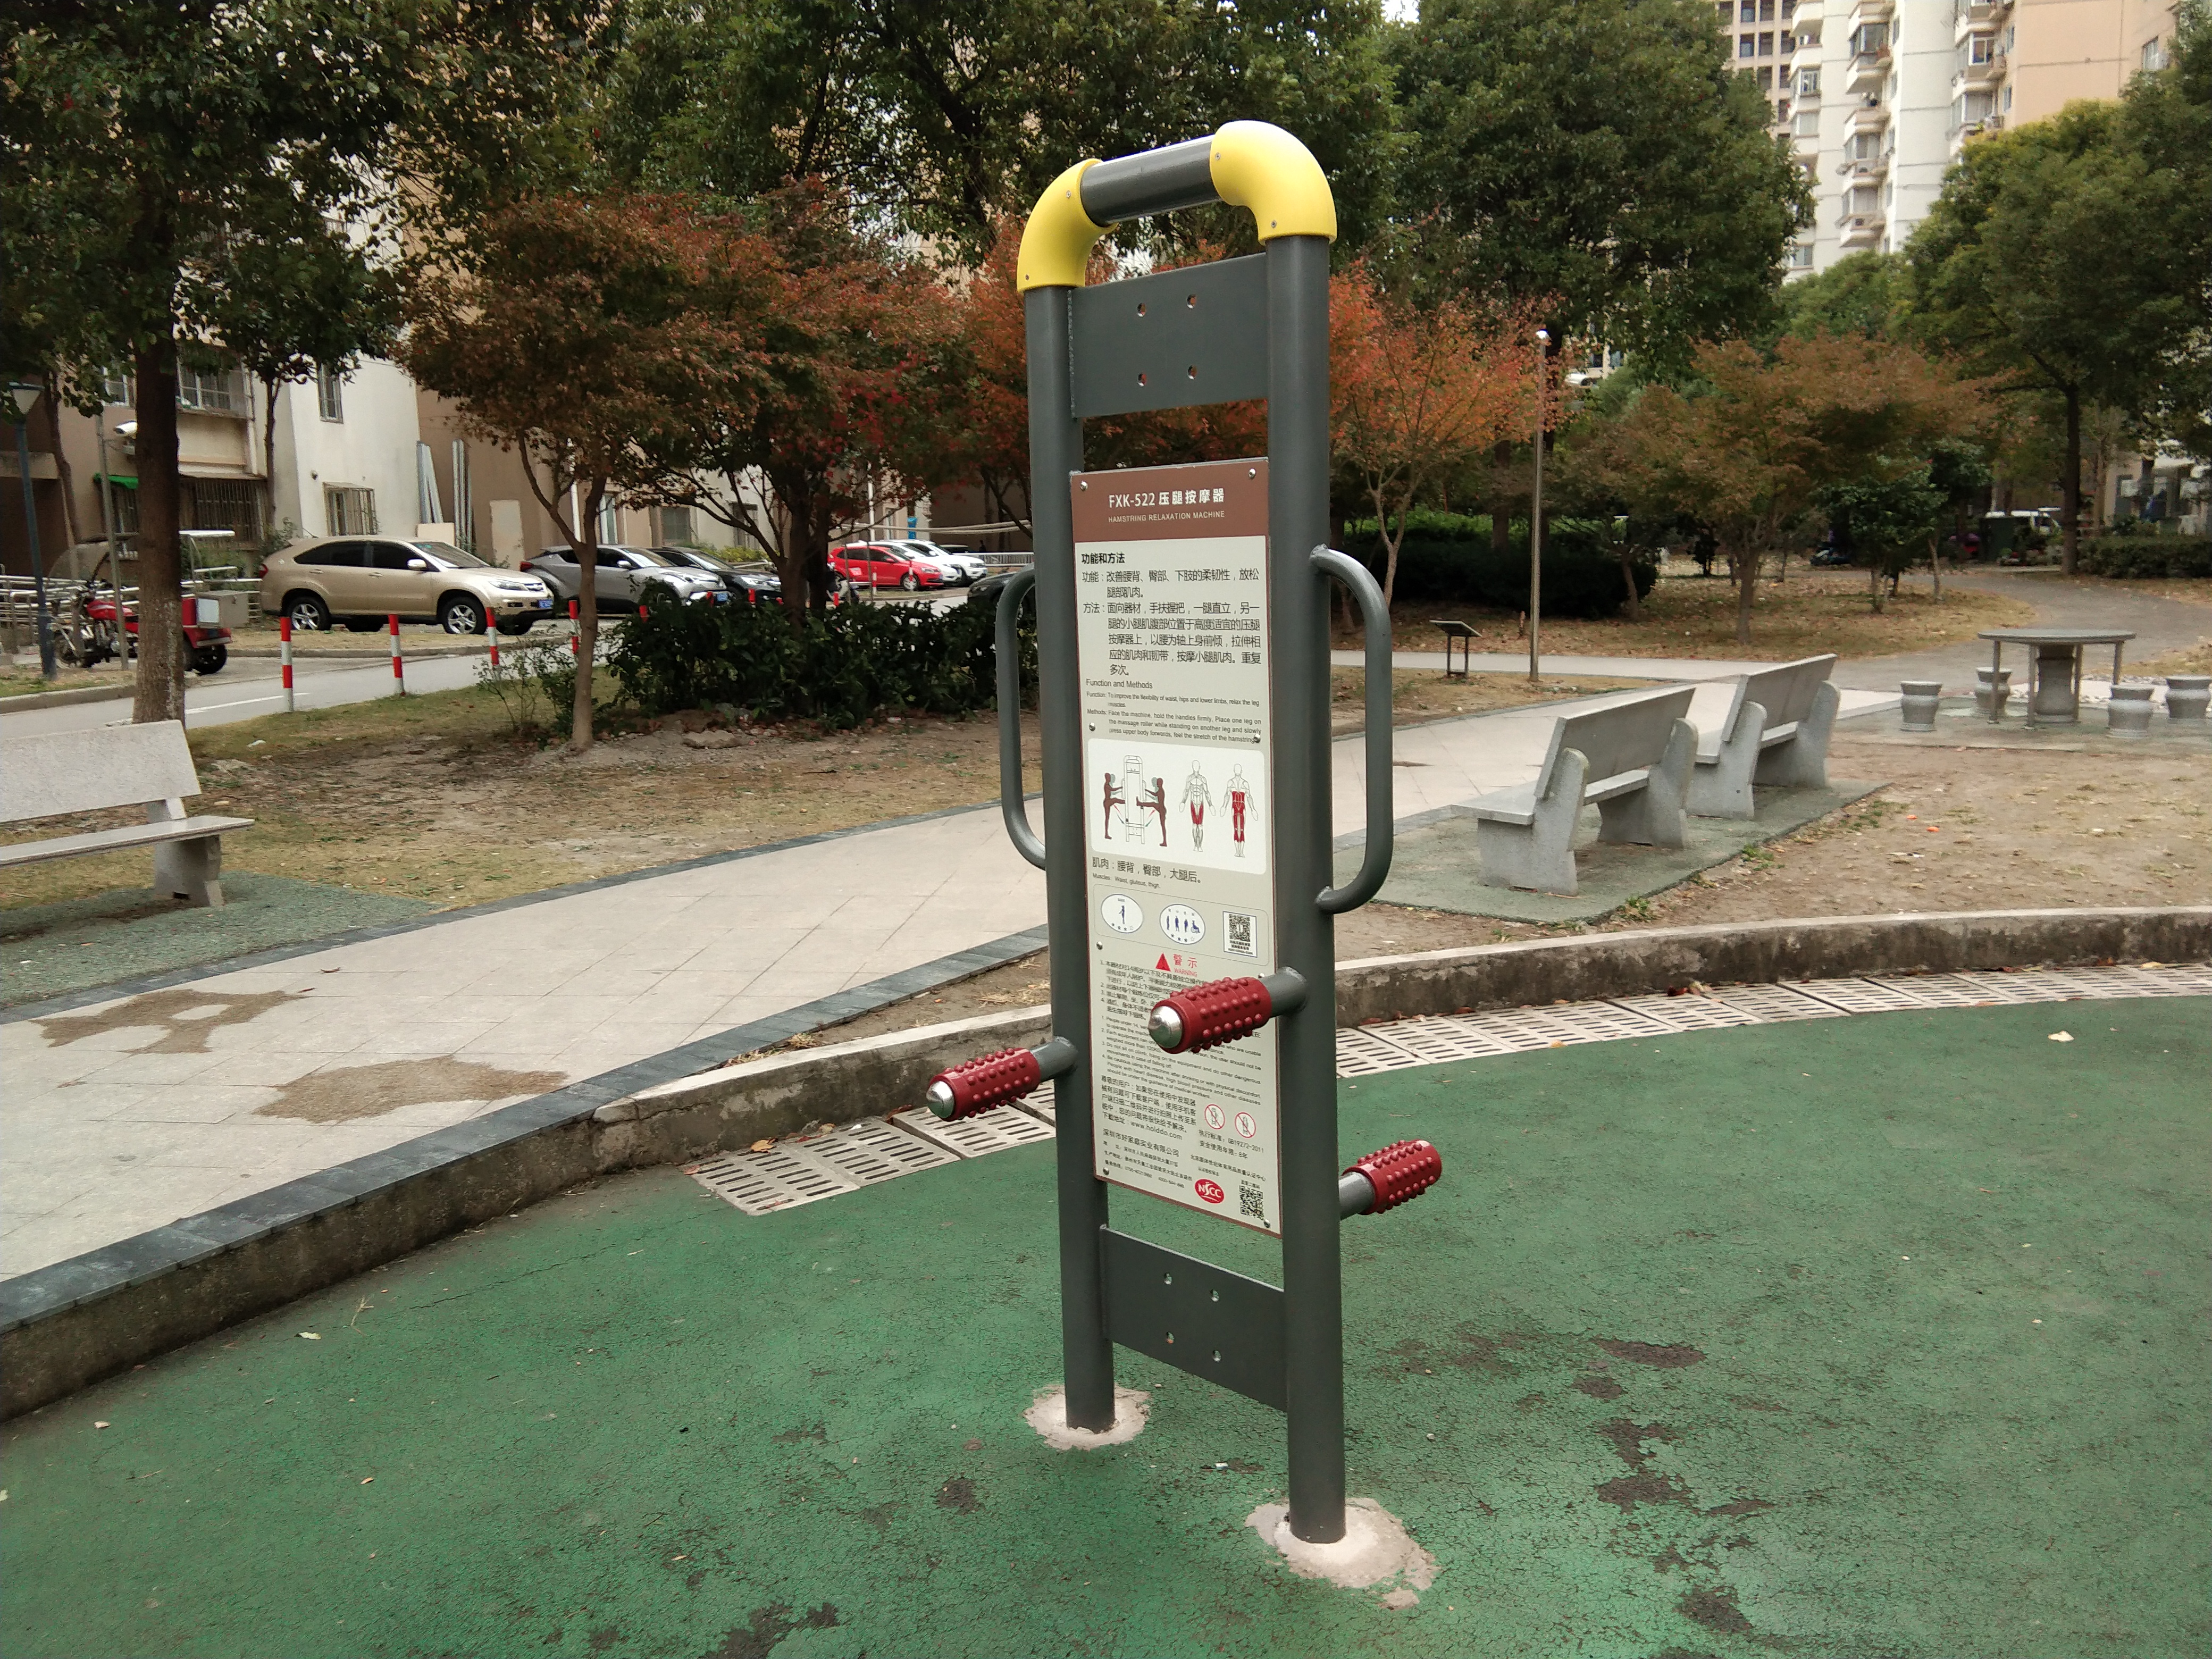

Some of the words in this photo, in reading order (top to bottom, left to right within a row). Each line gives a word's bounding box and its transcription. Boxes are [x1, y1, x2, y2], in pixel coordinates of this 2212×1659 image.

[1109, 492, 1155, 508] FXK-522
[1159, 488, 1225, 506] 压腿按摩器
[1108, 514, 1146, 523] HAMSTRING
[1149, 512, 1191, 521] RELAXATION
[1193, 510, 1225, 519] MACHINE
[1081, 552, 1126, 564] 功能和方法
[1086, 678, 1111, 686] Function
[1174, 968, 1197, 977] WARNING
[1198, 1182, 1221, 1198] NSCC
